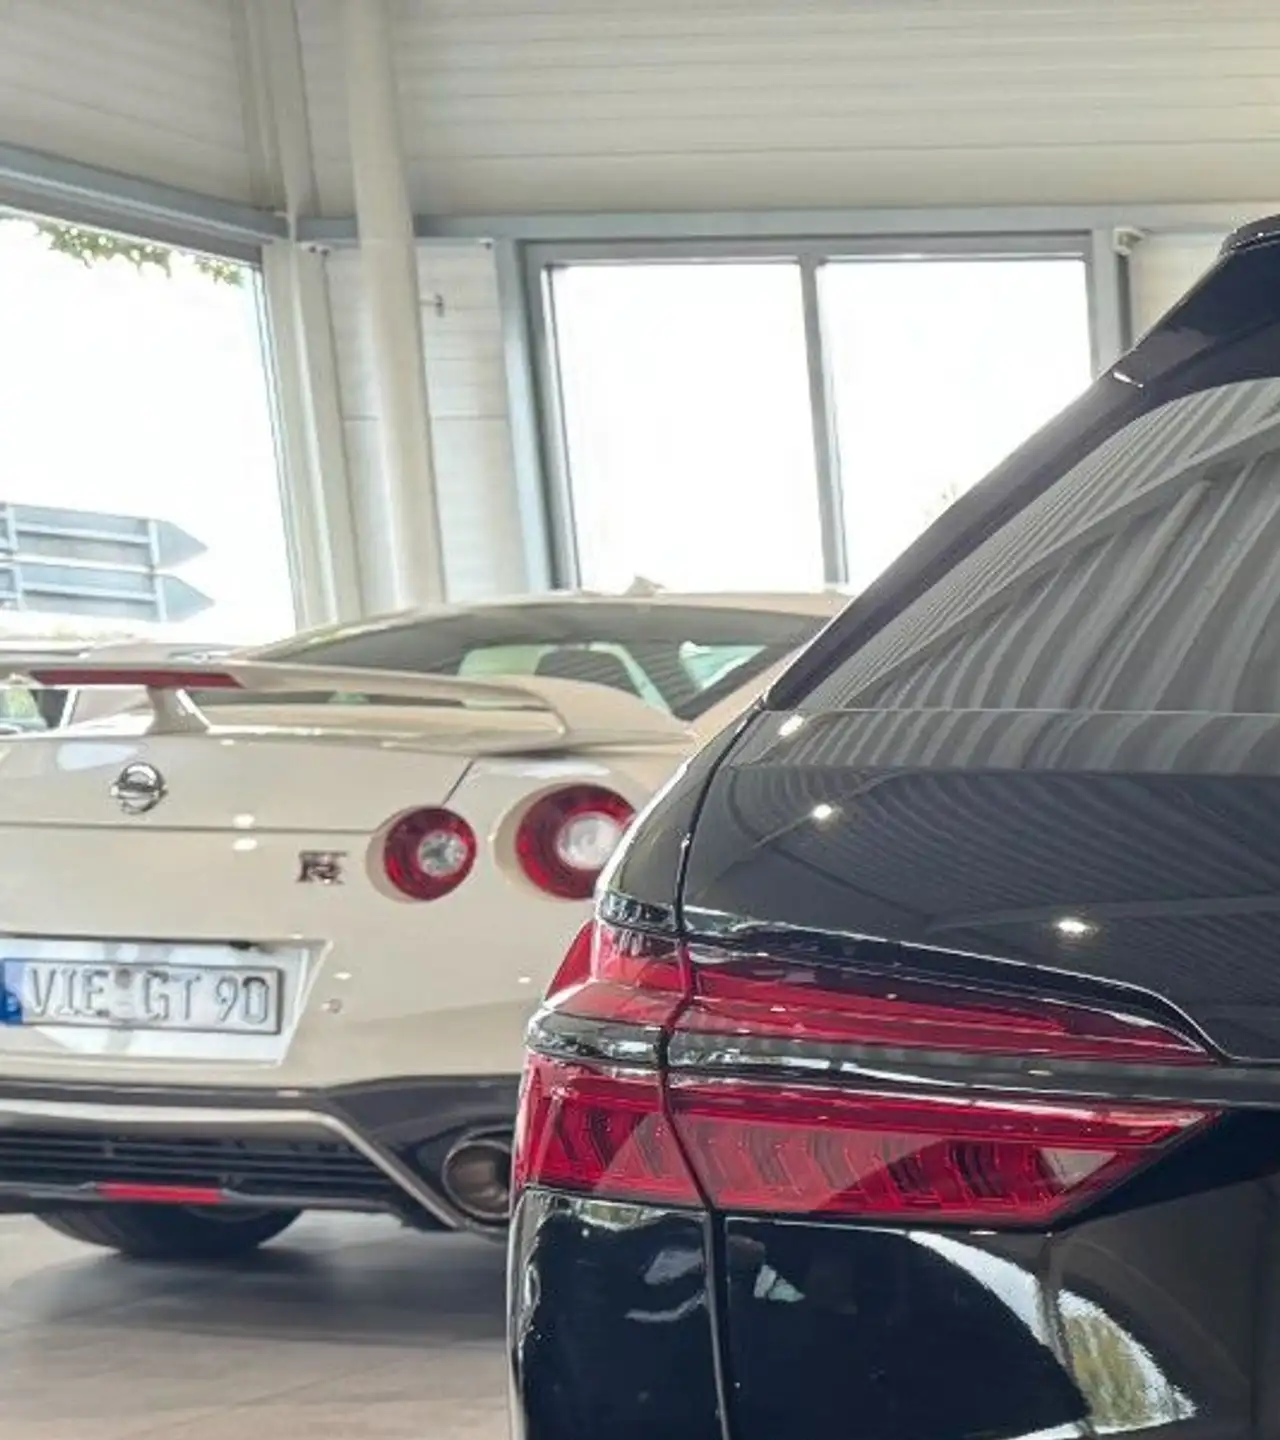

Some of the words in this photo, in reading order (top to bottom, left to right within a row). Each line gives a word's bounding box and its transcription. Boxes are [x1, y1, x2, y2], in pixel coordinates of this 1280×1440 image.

[27, 967, 109, 1018] VIE
[142, 969, 201, 1020] GT
[215, 974, 270, 1023] 90
